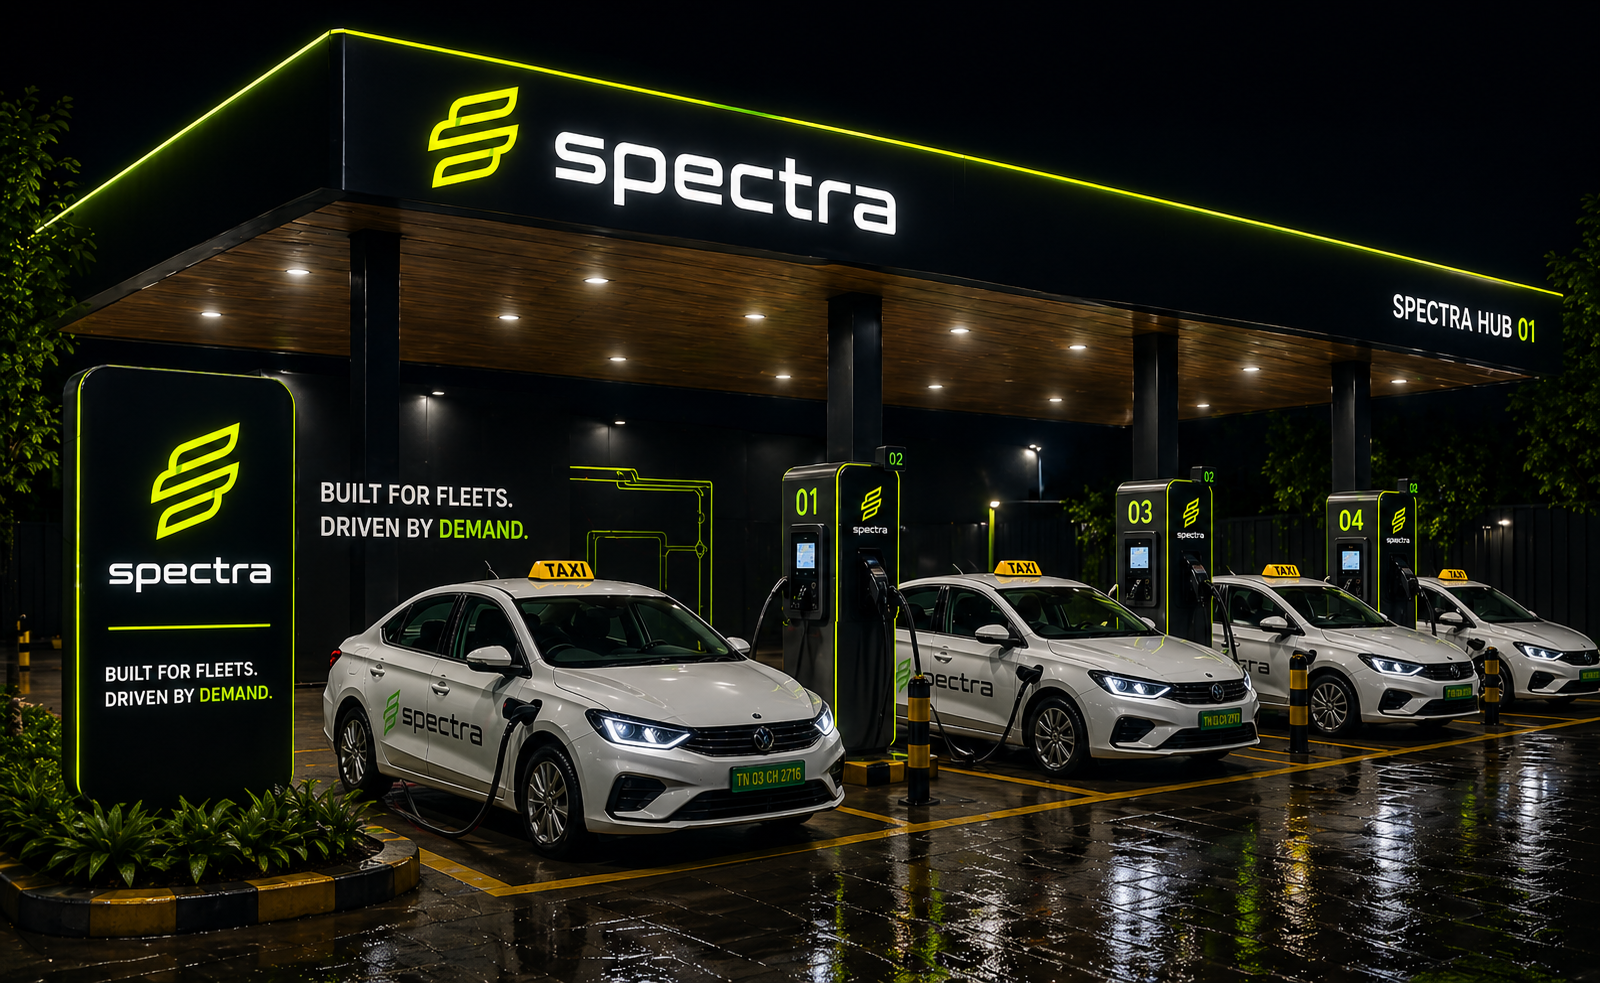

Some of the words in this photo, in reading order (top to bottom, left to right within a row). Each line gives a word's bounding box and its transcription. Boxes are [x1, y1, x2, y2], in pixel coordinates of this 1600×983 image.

[554, 131, 897, 236] spectra
[1392, 293, 1473, 332] SPECTRA
[1477, 310, 1513, 338] HUB
[1517, 317, 1535, 343] 01
[889, 452, 903, 466] 02
[1203, 470, 1215, 483] 02
[320, 482, 382, 504] BUILT
[388, 484, 430, 506] FOR
[436, 486, 514, 508] FLEETS.
[795, 487, 818, 517] 01
[1127, 499, 1153, 525] 03
[1339, 508, 1364, 532] 04
[320, 516, 400, 538] DRIVEN
[407, 518, 434, 539] BY
[439, 518, 530, 540] DEMAND.
[852, 525, 888, 536] spectra
[1176, 531, 1205, 541] spectra
[108, 556, 272, 593] spectra
[544, 563, 587, 578] TAXI
[1007, 562, 1038, 574] TAXI
[1273, 566, 1297, 576] TAXI
[105, 665, 153, 683] BUILT
[158, 664, 191, 680] FOR
[196, 661, 258, 679] FLEETS.
[921, 671, 994, 698] pectra
[105, 689, 168, 708] DRIVEN
[173, 687, 195, 704] BY
[199, 685, 273, 703] DEMAND.
[402, 707, 483, 747] spectra
[737, 772, 750, 787] TN
[752, 771, 764, 785] 03
[766, 769, 779, 783] CH
[781, 767, 801, 782] 2716
